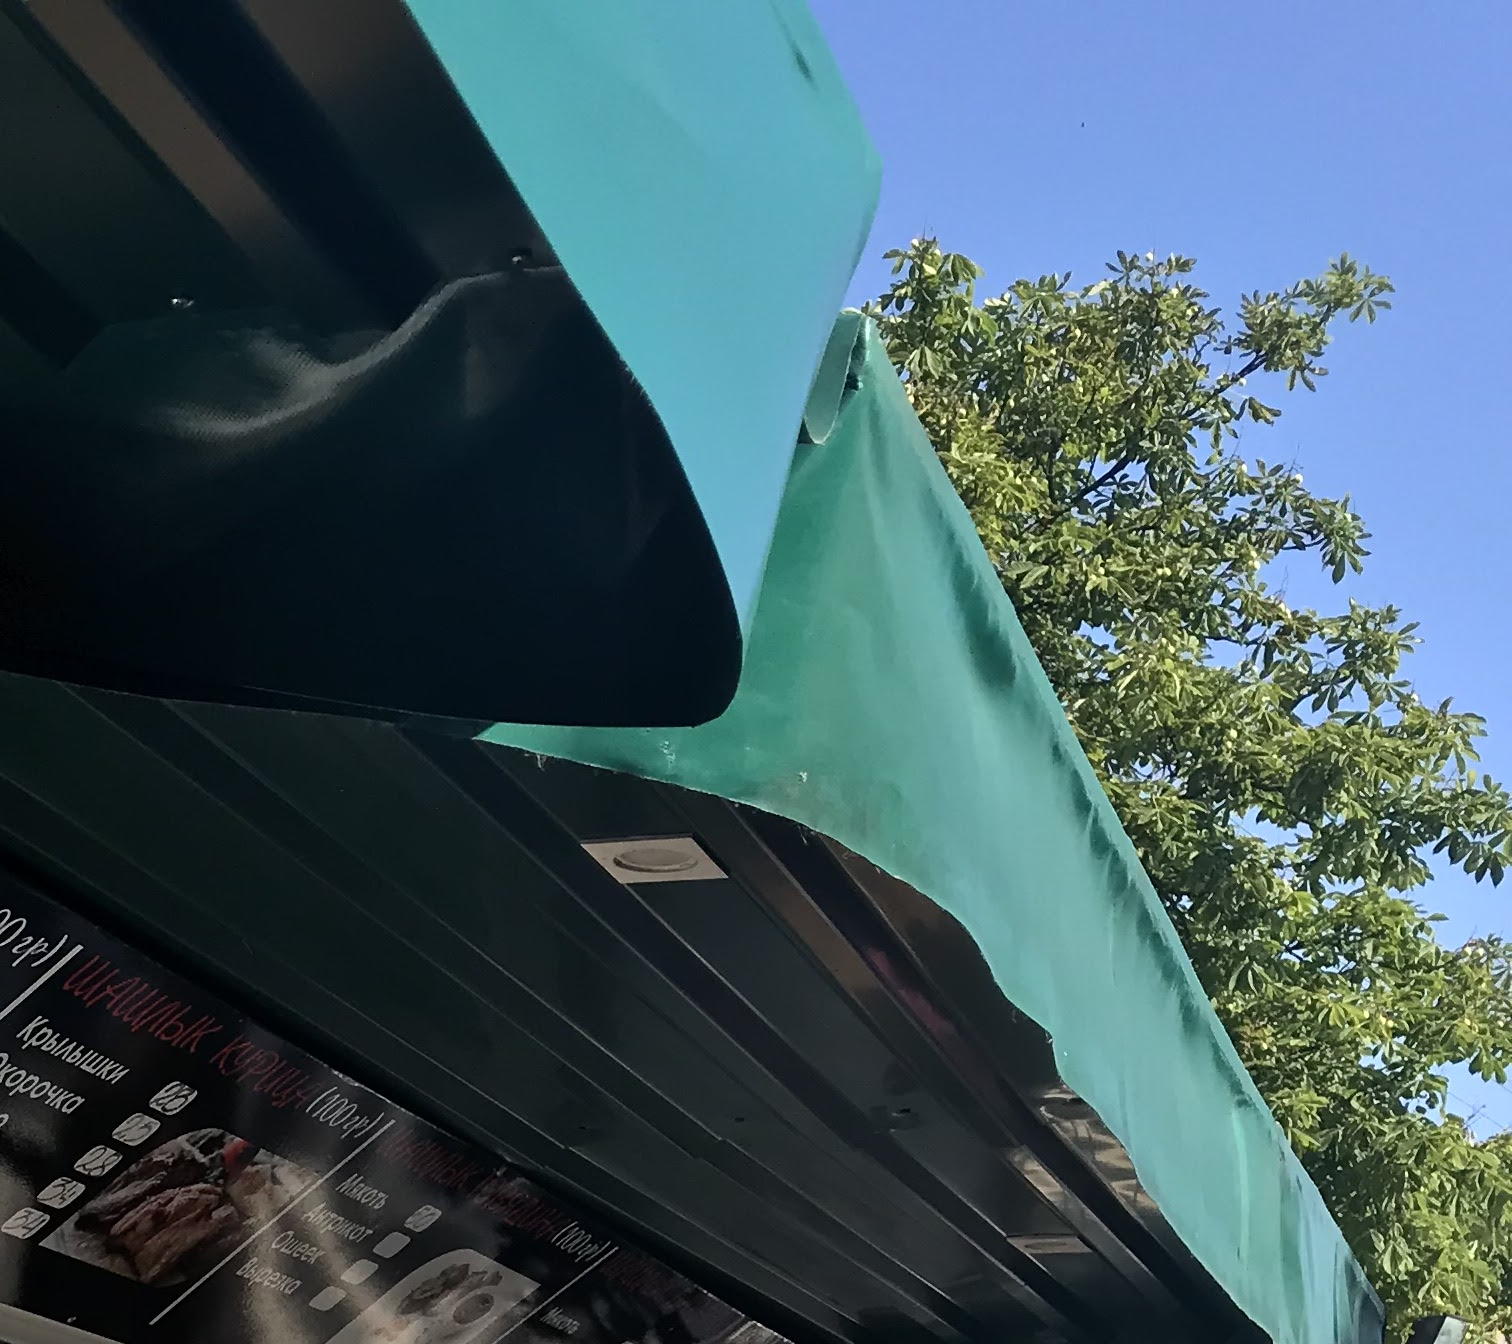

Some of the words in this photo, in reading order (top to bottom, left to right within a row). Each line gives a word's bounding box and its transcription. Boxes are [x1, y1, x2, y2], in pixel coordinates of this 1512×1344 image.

[61, 953, 222, 1054] ШАШЛЫК
[15, 1015, 130, 1085] Крылышки
[301, 1202, 375, 1244] Антрикот
[271, 1230, 326, 1264] Ошеек
[236, 1257, 303, 1295] Вырезка
